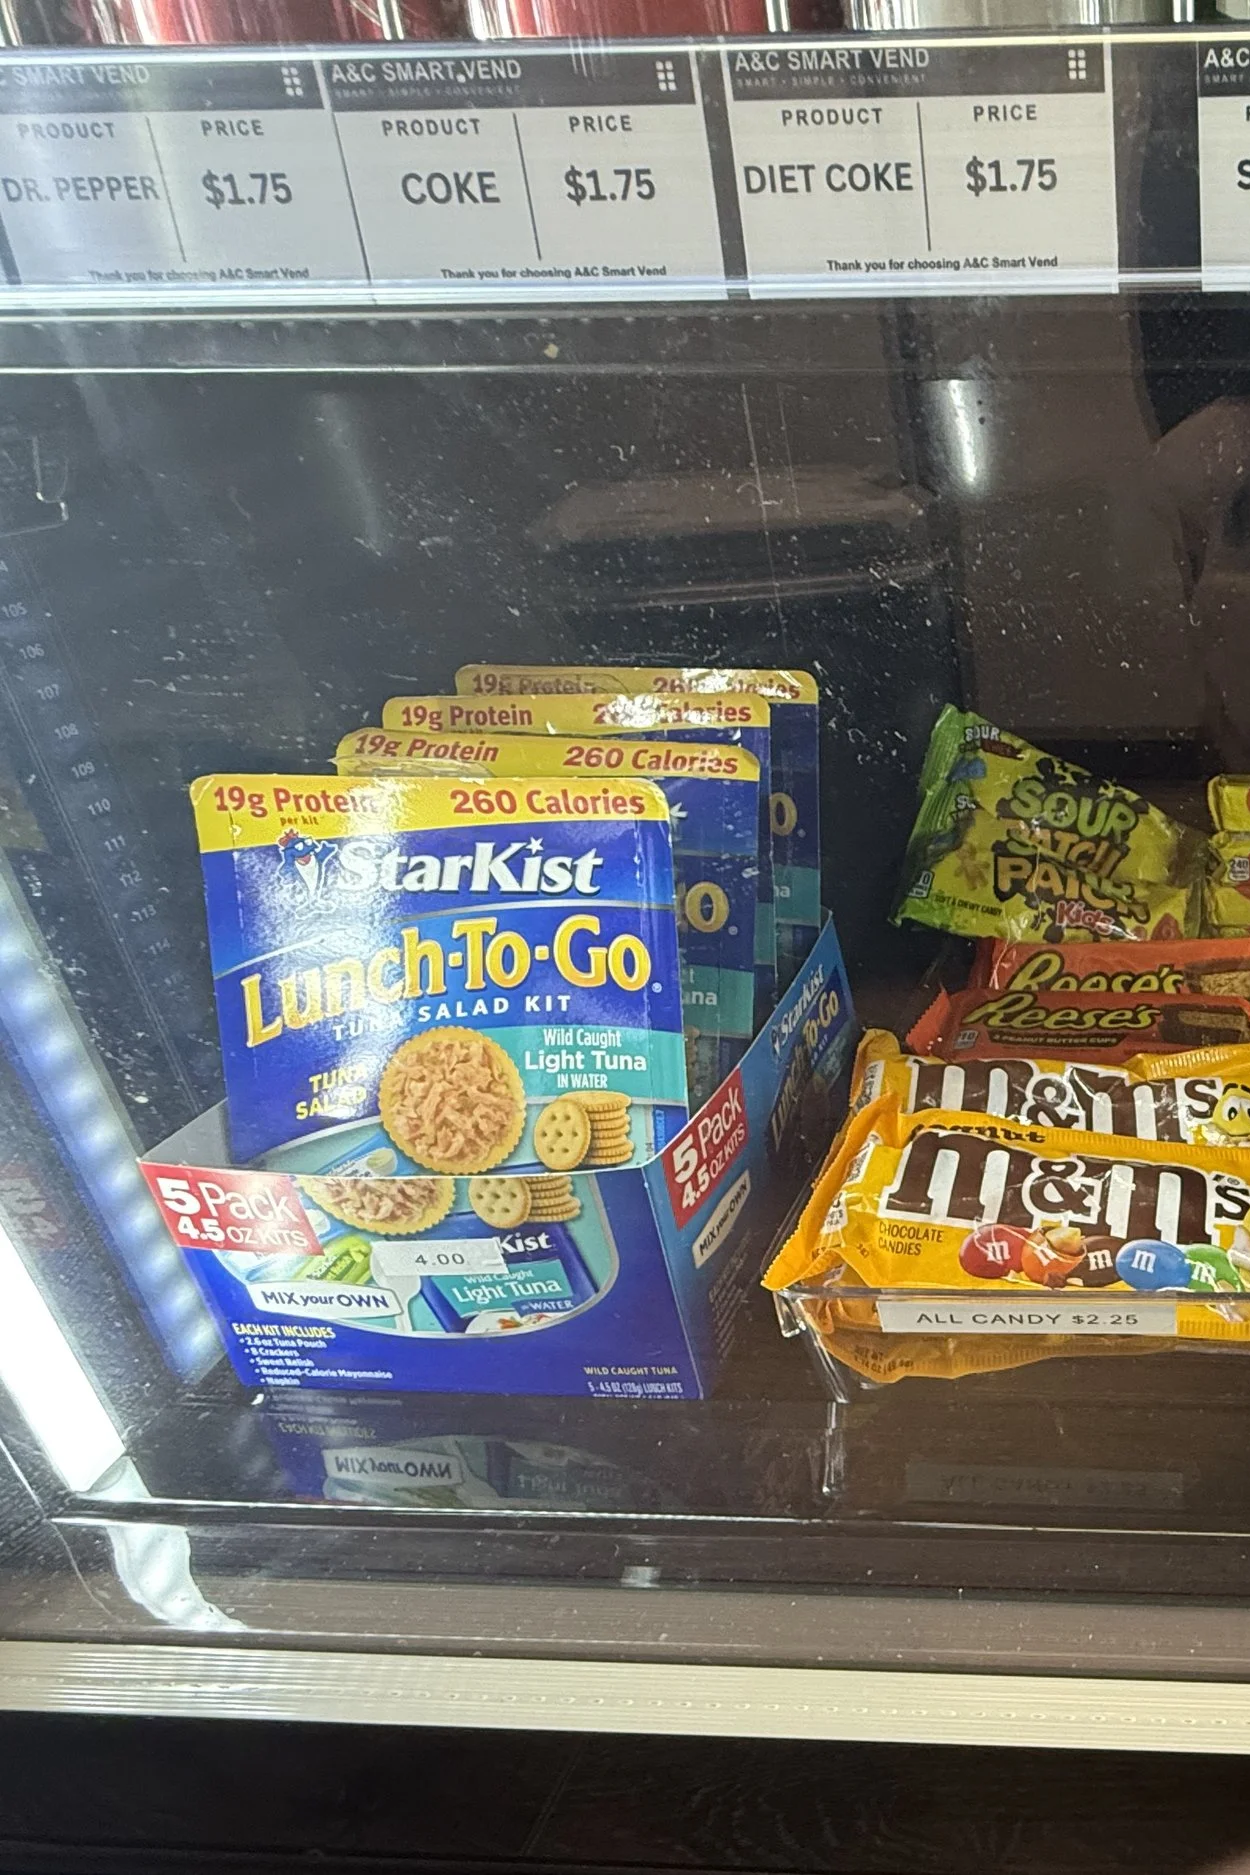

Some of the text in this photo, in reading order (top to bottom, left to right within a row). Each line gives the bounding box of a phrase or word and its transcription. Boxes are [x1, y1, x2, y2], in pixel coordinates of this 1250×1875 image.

[735, 47, 930, 72] A&C SMART VEND
[1204, 47, 1250, 67] A&C
[12, 63, 150, 86] SMART VEND
[331, 59, 522, 83] A&C SMART VEND
[568, 115, 632, 132] PRICE
[782, 108, 882, 125] PRODUCT
[973, 104, 1037, 121] PRICE
[17, 122, 115, 139] PRODUCT
[202, 120, 264, 136] PRICE
[381, 119, 480, 136] PRODUCT
[401, 171, 501, 205] COKE
[564, 165, 656, 206] $1.75
[744, 162, 913, 194] DIET COKE
[965, 156, 1057, 196] $1.75
[2, 176, 160, 202] DR. PEPPER
[202, 169, 293, 210] $1.75
[401, 706, 442, 731] 19g
[449, 704, 532, 727] Protein
[354, 733, 738, 775] 19g Protein 260 Calories
[214, 785, 267, 818] 19g
[451, 788, 518, 815] 260
[526, 787, 645, 816] Calories
[1008, 778, 1140, 845] SOUR
[338, 836, 603, 895] StarKist
[418, 995, 571, 1022] SALAD KIT
[962, 993, 1161, 1029] Reese's
[543, 1028, 622, 1049] Wild Caught
[525, 1050, 647, 1074] Light Tuna
[557, 1073, 608, 1088] IN WATER
[673, 1086, 743, 1184] 5 Pack
[681, 1123, 746, 1208] 4.5 OZ KITS
[155, 1177, 300, 1222] 5 Pack
[177, 1216, 308, 1248] 4.5 OZ KITS
[879, 1221, 944, 1243] CHOCOLATE
[878, 1238, 922, 1256] CANDIES
[261, 1290, 390, 1309] MIX your OWN
[452, 1278, 562, 1304] Light Tuna
[232, 1323, 263, 1336] EACH
[282, 1325, 337, 1339] INCLUDES
[917, 1313, 1139, 1326] ALL CANDY $2.25
[584, 1366, 678, 1376] WILD CAUGHT TUNA
